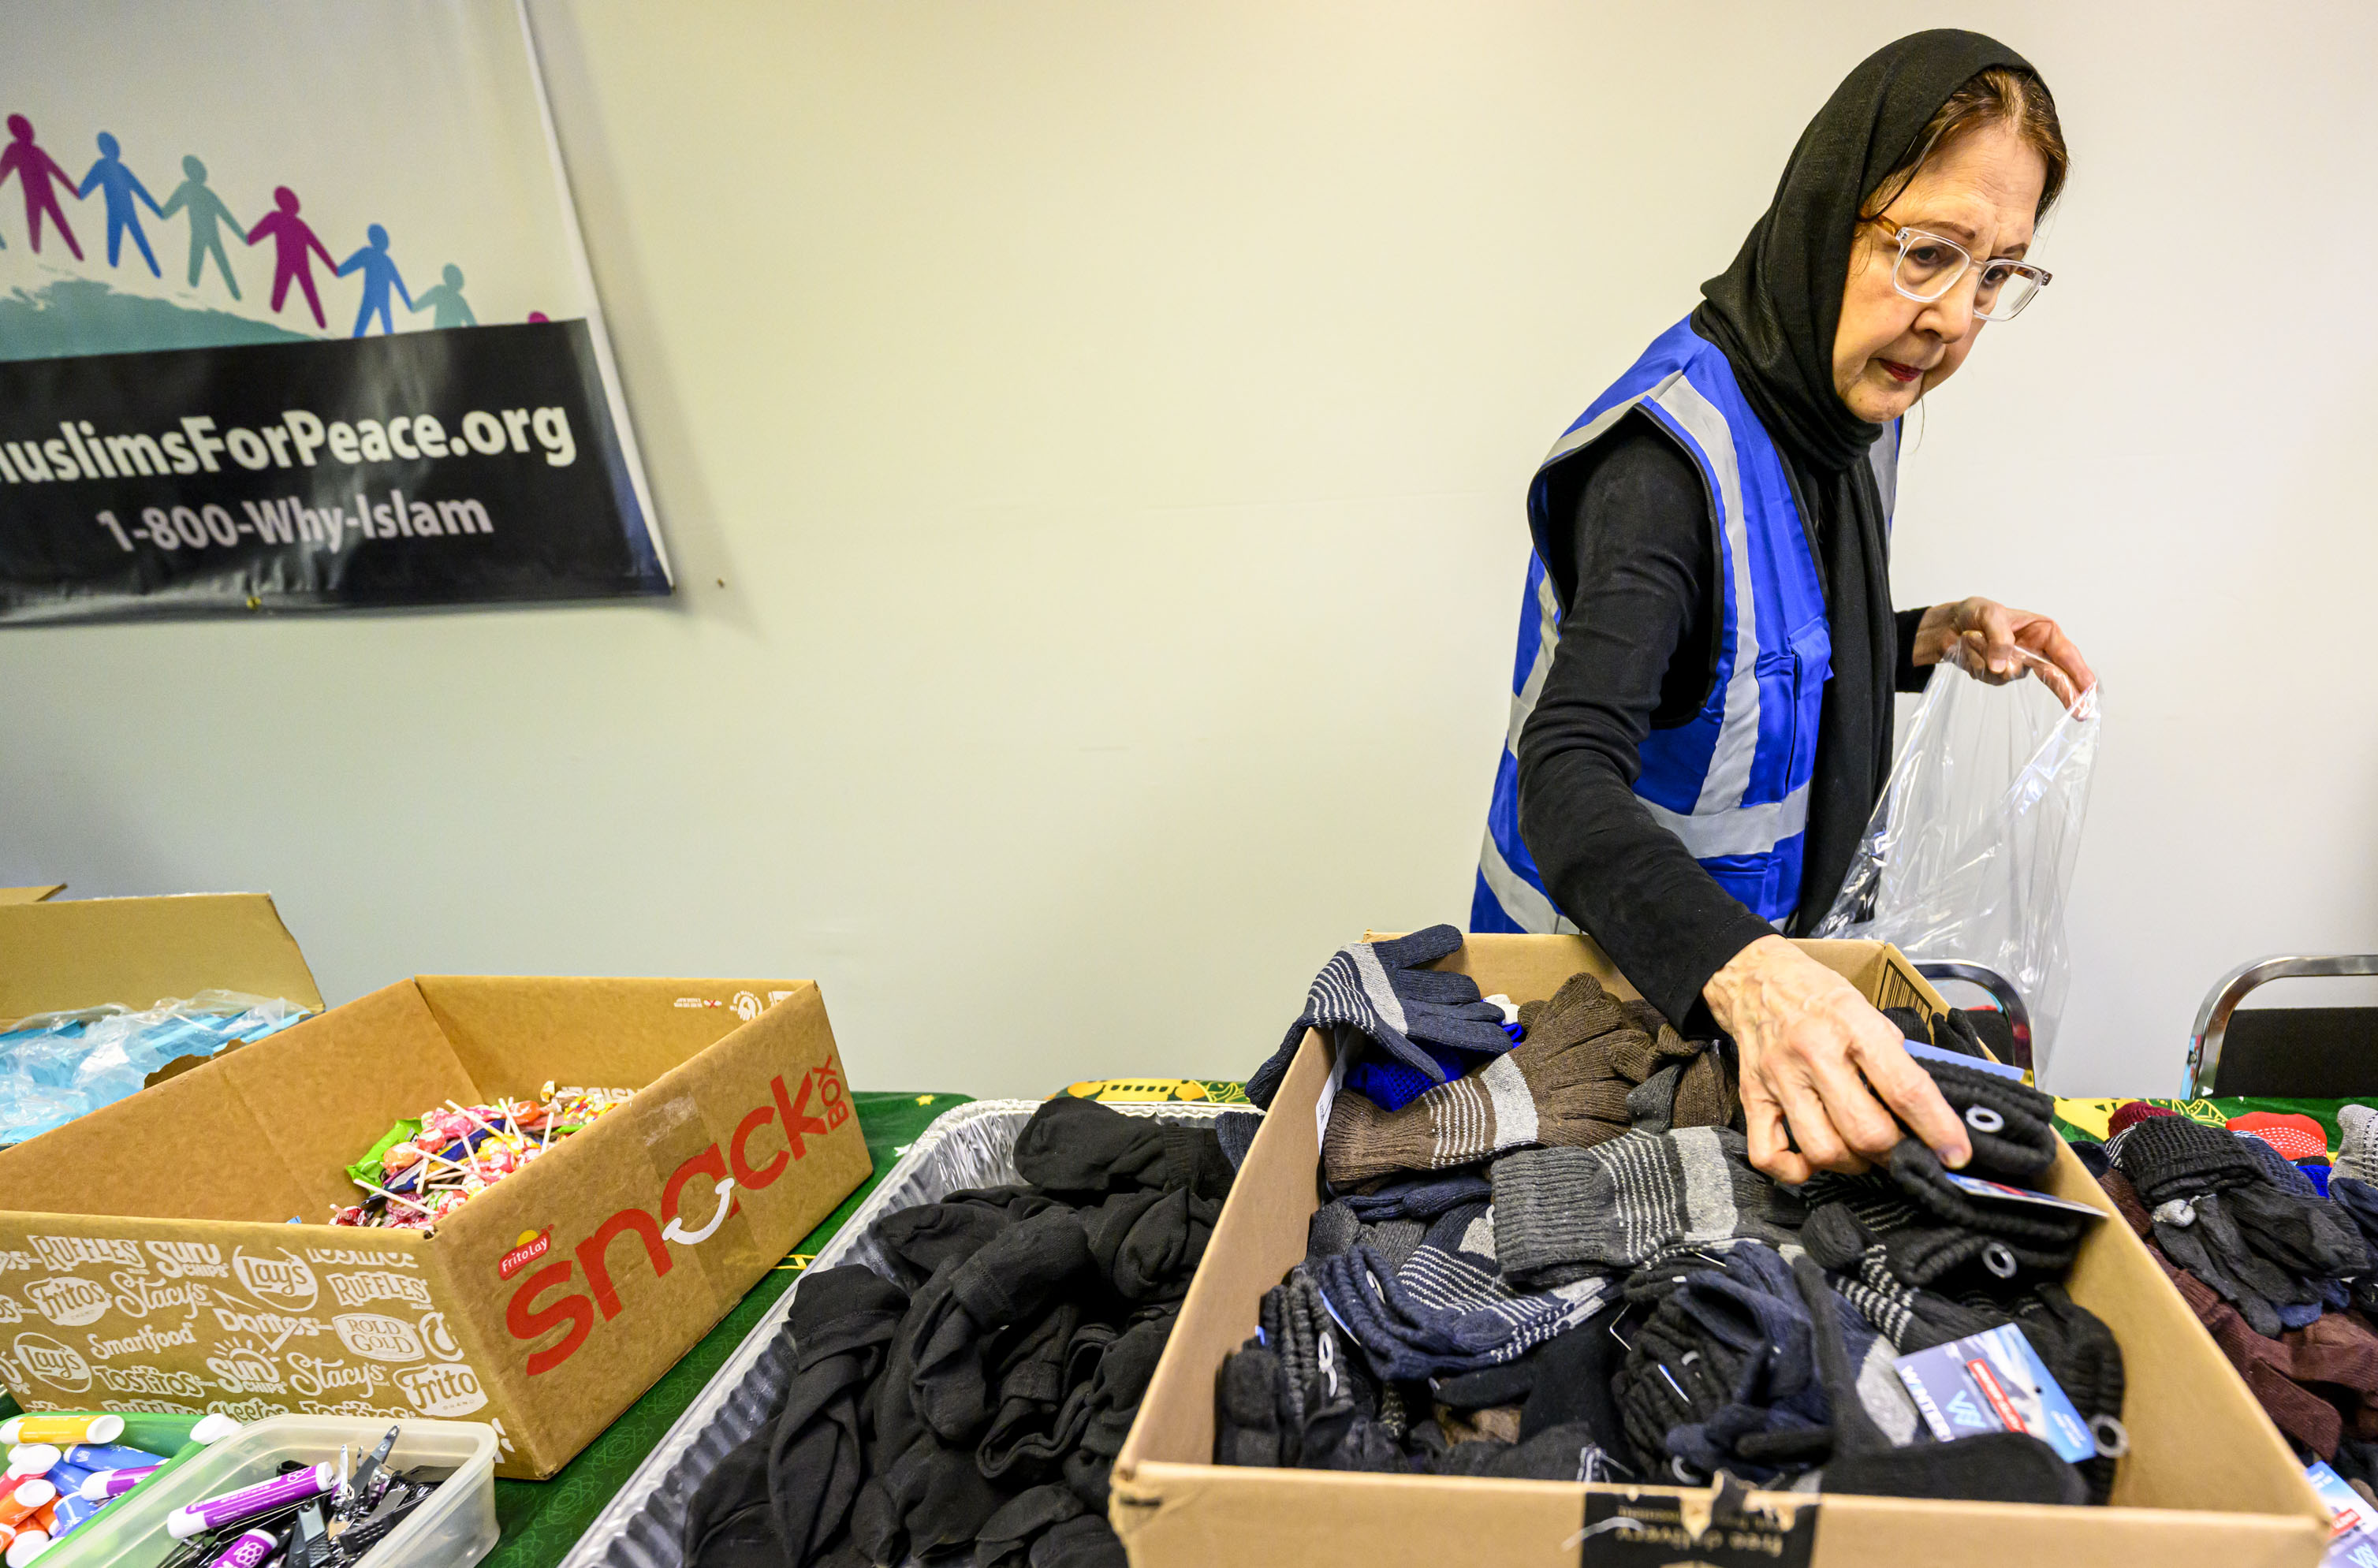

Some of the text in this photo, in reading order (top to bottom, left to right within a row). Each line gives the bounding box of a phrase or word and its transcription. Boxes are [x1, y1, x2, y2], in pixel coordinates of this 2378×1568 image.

[97, 489, 494, 554] 1-800-Why-Islam
[813, 1053, 849, 1130] BOX
[506, 1071, 829, 1376] snack
[182, 1263, 229, 1278] CHIPS
[242, 1258, 308, 1295] Lay's
[330, 1272, 429, 1304] RUFFLES
[27, 1279, 106, 1320] Fritos
[110, 1271, 208, 1320] Stacy's
[213, 1308, 319, 1336] Doritos
[346, 1318, 401, 1335] ROLD
[88, 1323, 196, 1360] Smartfood
[350, 1334, 415, 1354] GOLD
[22, 1345, 80, 1380] Lay's
[285, 1351, 385, 1398] Stacy's
[242, 1380, 287, 1395] CHIPS
[1900, 1365, 1951, 1440] WINTER
